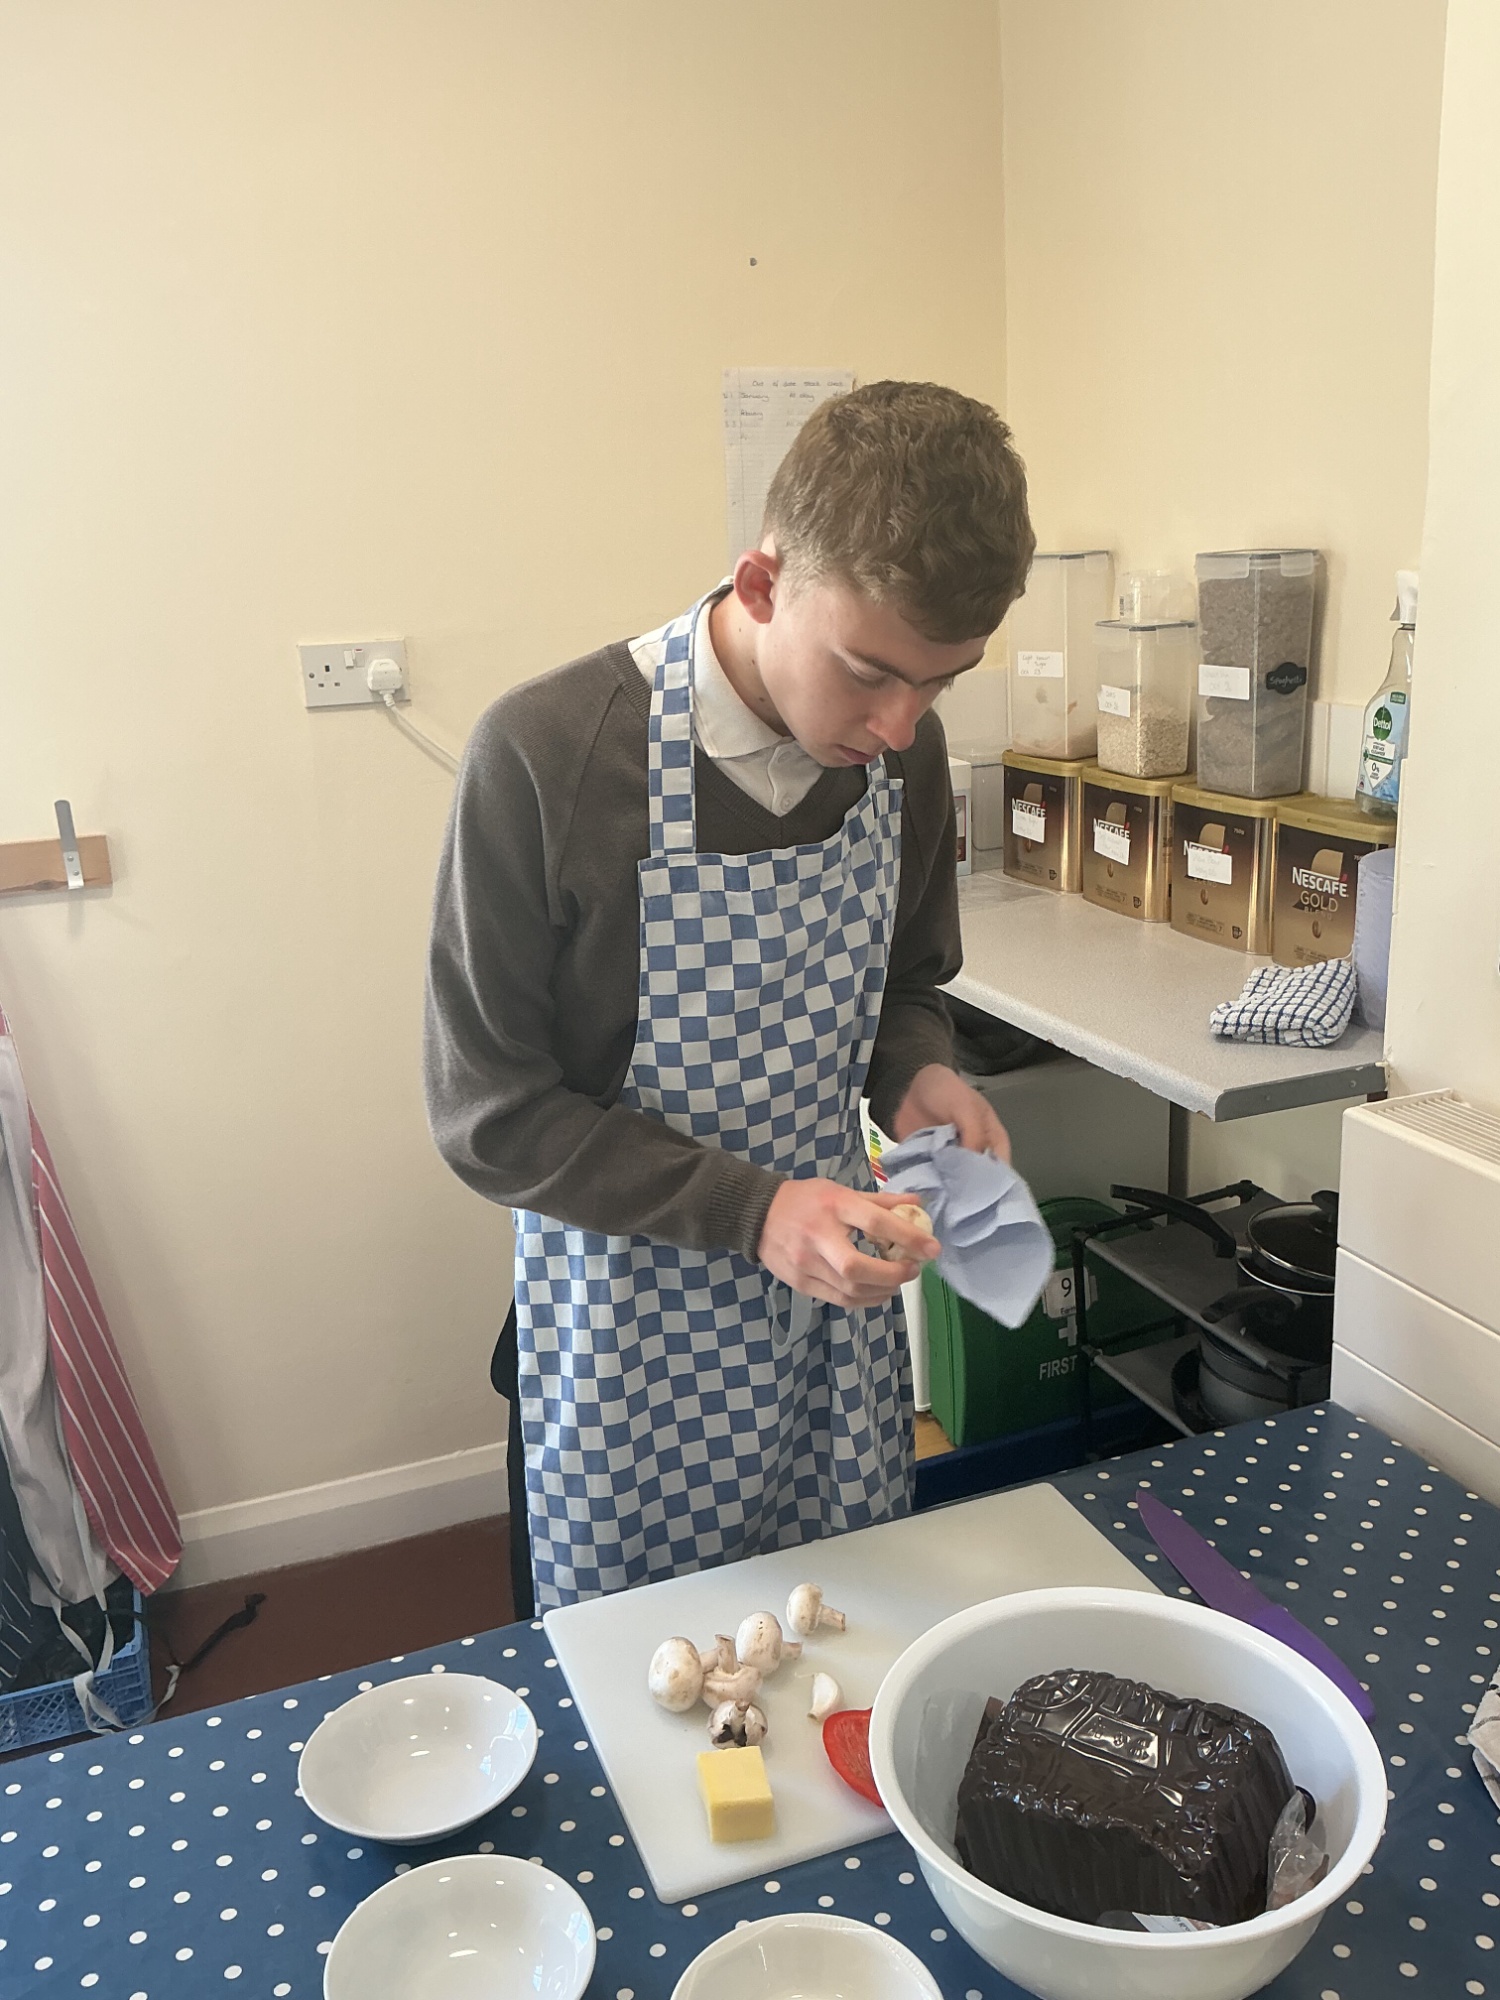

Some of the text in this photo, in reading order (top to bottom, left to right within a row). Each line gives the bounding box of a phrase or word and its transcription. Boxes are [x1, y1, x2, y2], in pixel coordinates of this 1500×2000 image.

[740, 392, 770, 402] January
[1373, 716, 1392, 731] Dettol
[1300, 890, 1339, 912] GOLD
[1061, 1277, 1072, 1298] 9
[1039, 1354, 1078, 1381] FIRST
